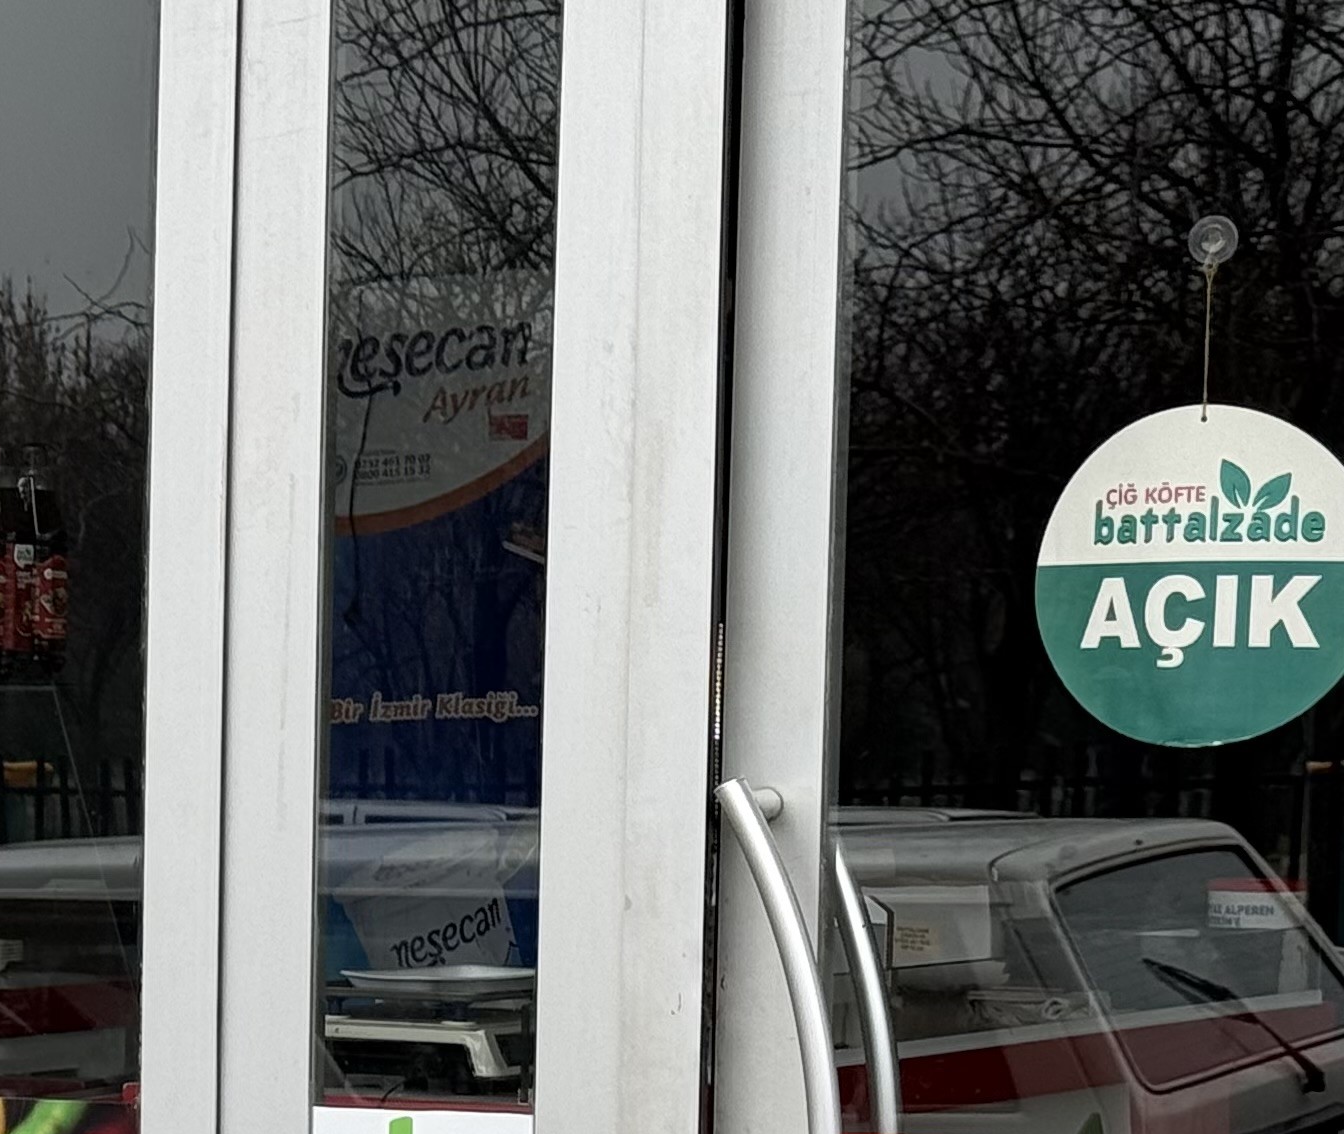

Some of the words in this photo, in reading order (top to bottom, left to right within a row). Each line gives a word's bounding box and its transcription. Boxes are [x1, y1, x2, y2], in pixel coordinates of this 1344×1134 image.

[423, 374, 529, 423] Ayran
[1106, 484, 1137, 508] ÇİĞ
[1145, 482, 1206, 504] KÖFTE
[1094, 495, 1325, 545] battalzade
[1080, 575, 1322, 667] AÇIK
[331, 698, 363, 722] Bir
[369, 690, 431, 721] İzmir
[390, 898, 501, 968] neşecan
